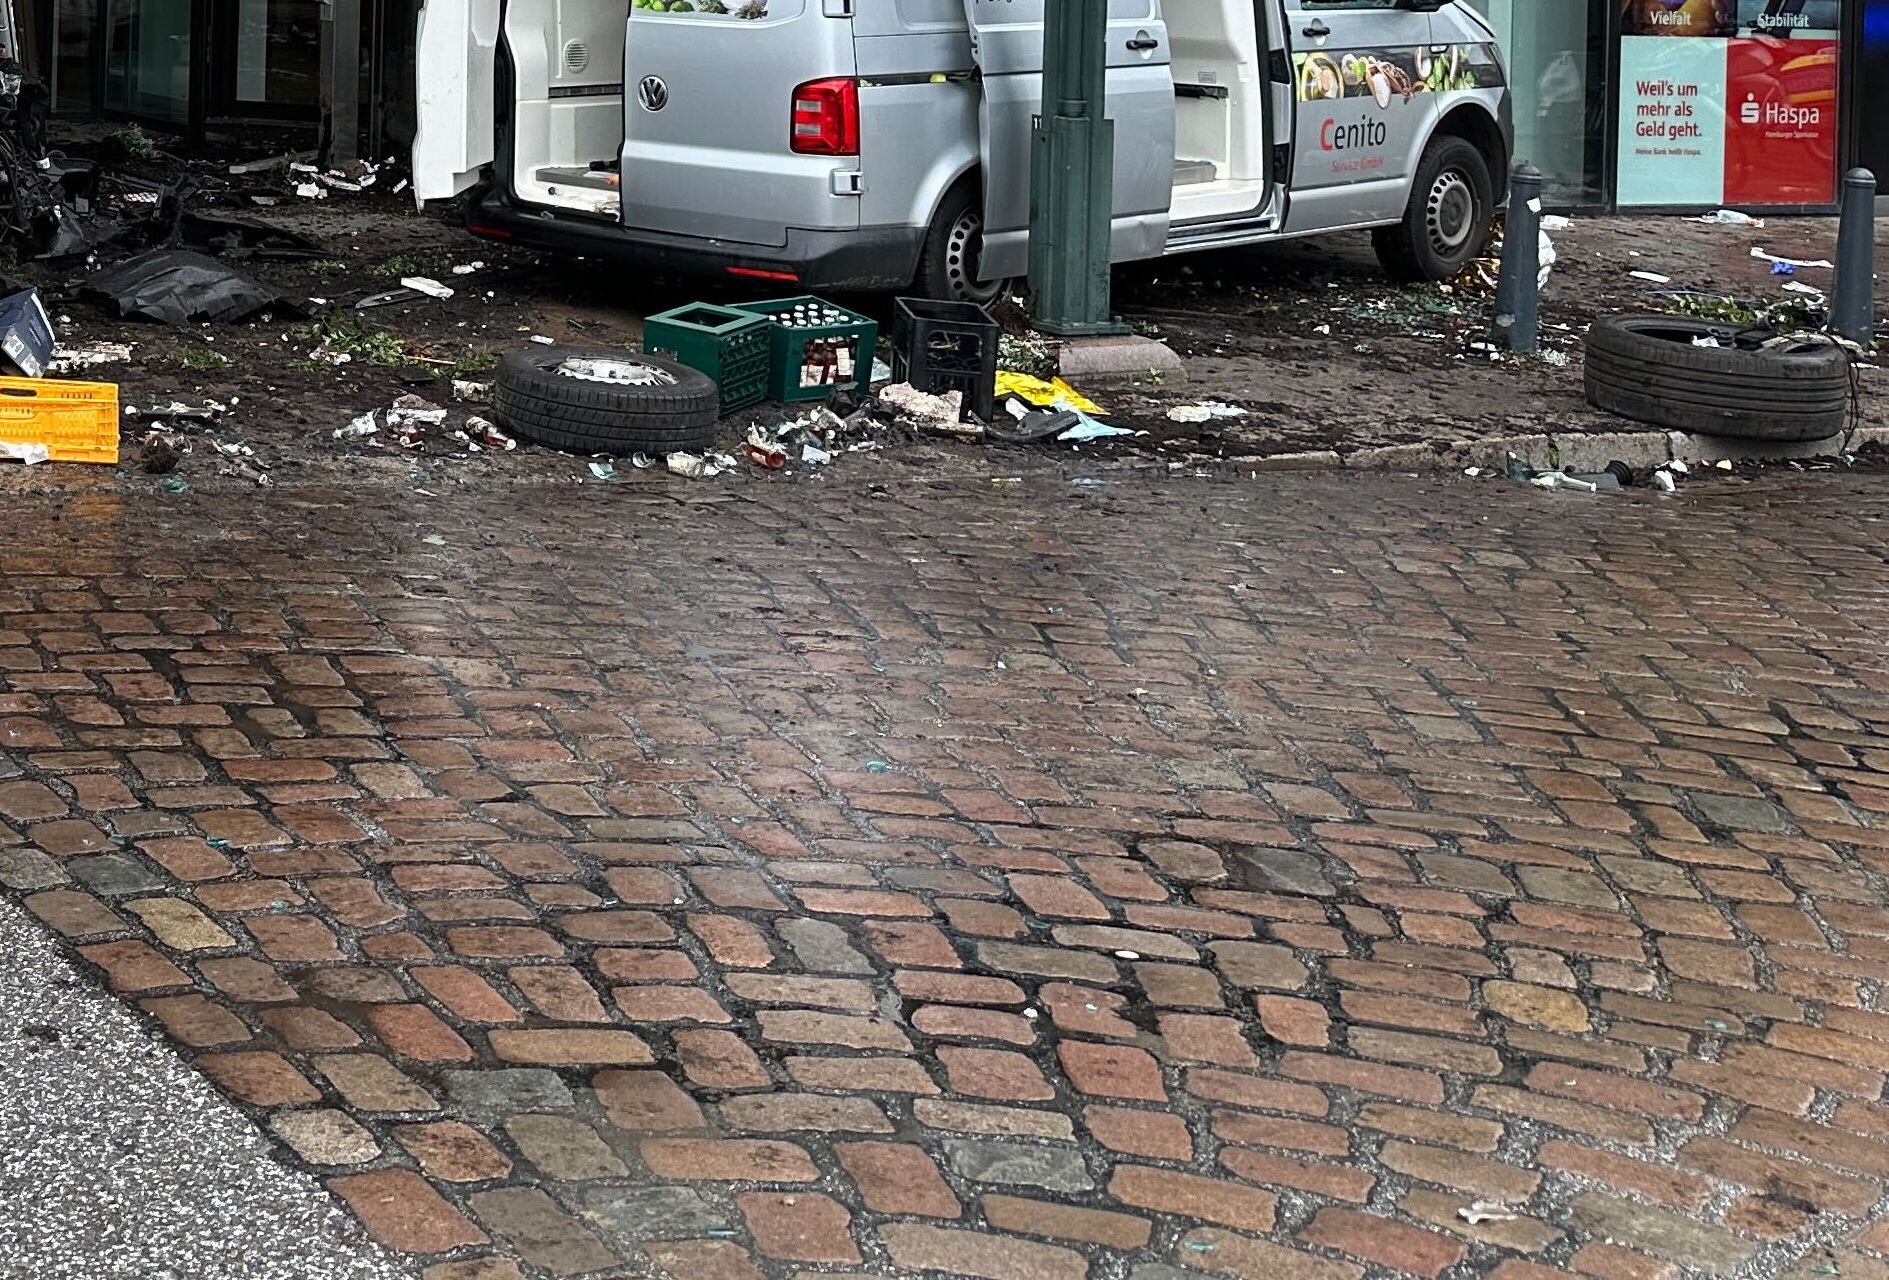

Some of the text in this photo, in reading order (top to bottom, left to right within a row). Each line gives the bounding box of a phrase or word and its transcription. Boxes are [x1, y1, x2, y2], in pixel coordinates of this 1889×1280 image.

[1650, 11, 1692, 25] Vielfalt
[1757, 12, 1810, 27] Stabilität
[1677, 84, 1698, 96] um
[1637, 101, 1693, 117] mehr als
[1766, 102, 1819, 129] Haspa
[1320, 114, 1386, 151] Cenito
[1636, 121, 1702, 140] Geld geht.
